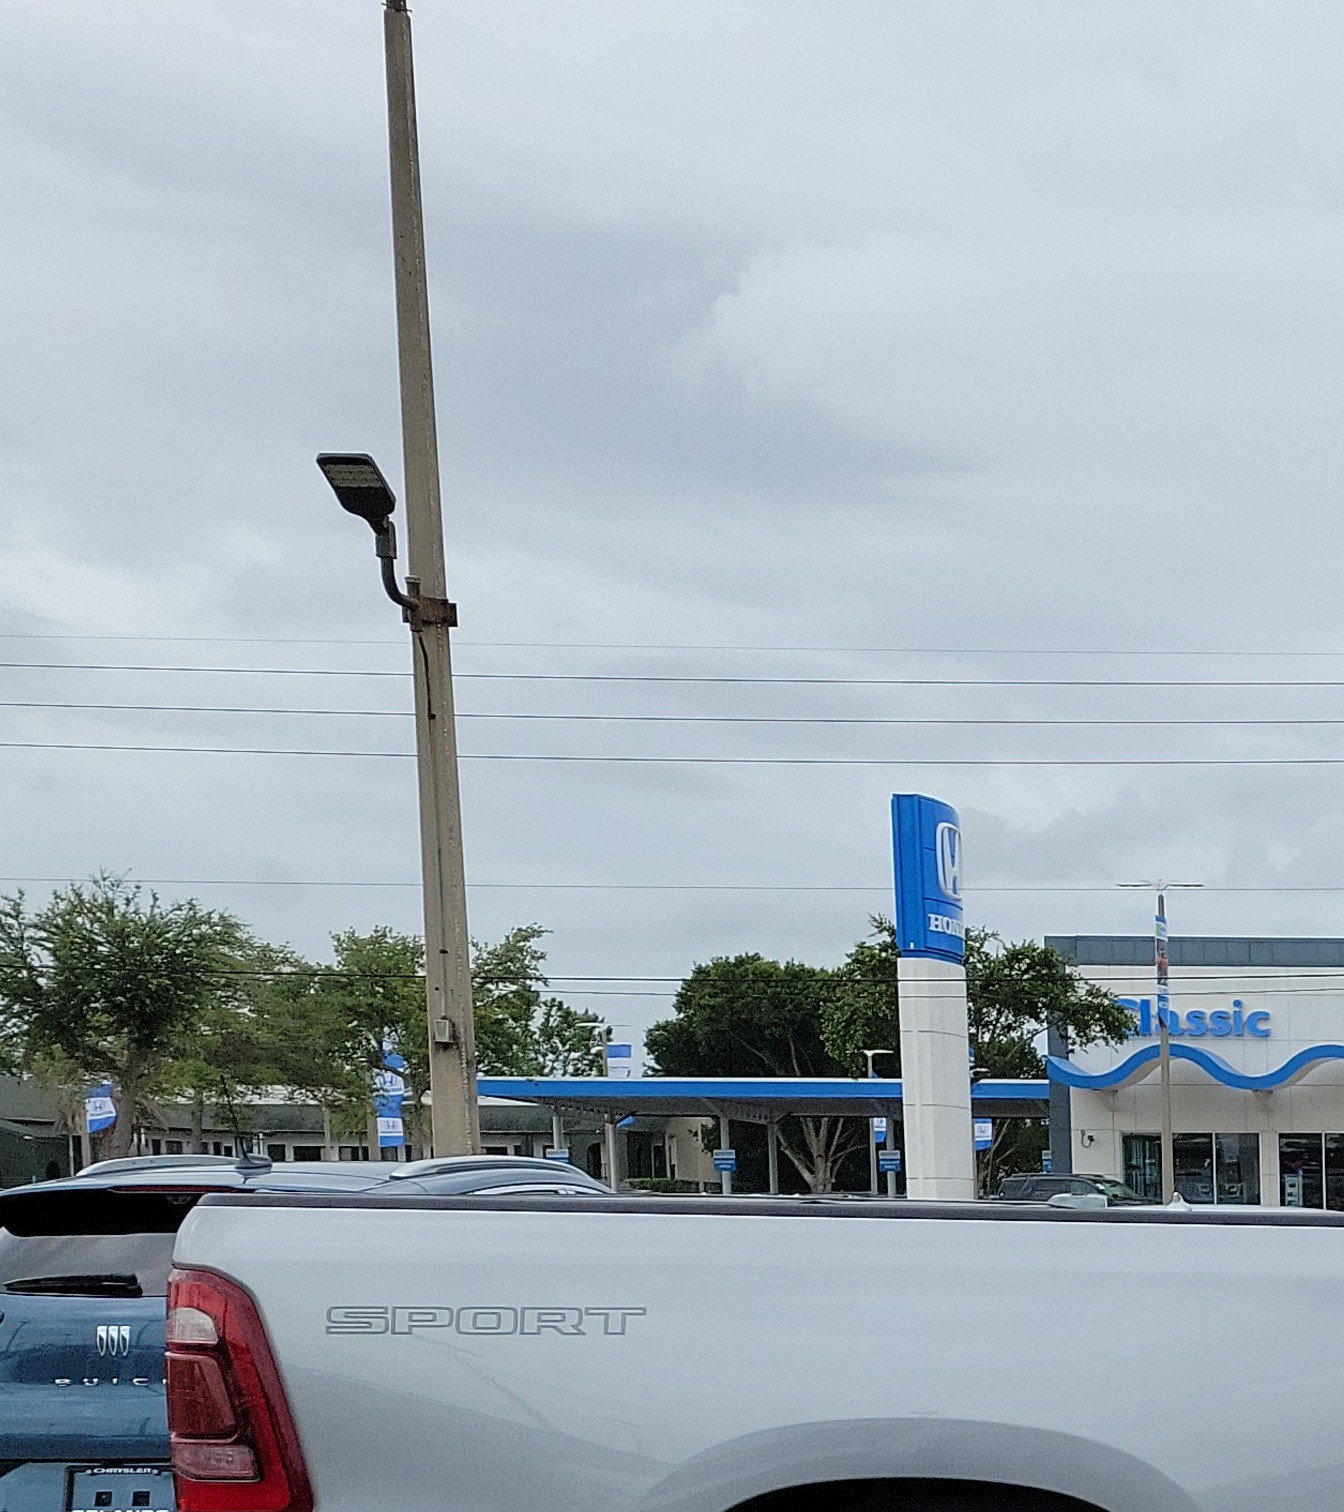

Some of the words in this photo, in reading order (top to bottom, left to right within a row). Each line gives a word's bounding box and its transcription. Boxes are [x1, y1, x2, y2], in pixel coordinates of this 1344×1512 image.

[326, 1305, 647, 1335] SPORT
[54, 1377, 168, 1387] BUIC
[93, 1467, 152, 1475] CHRYSLER
